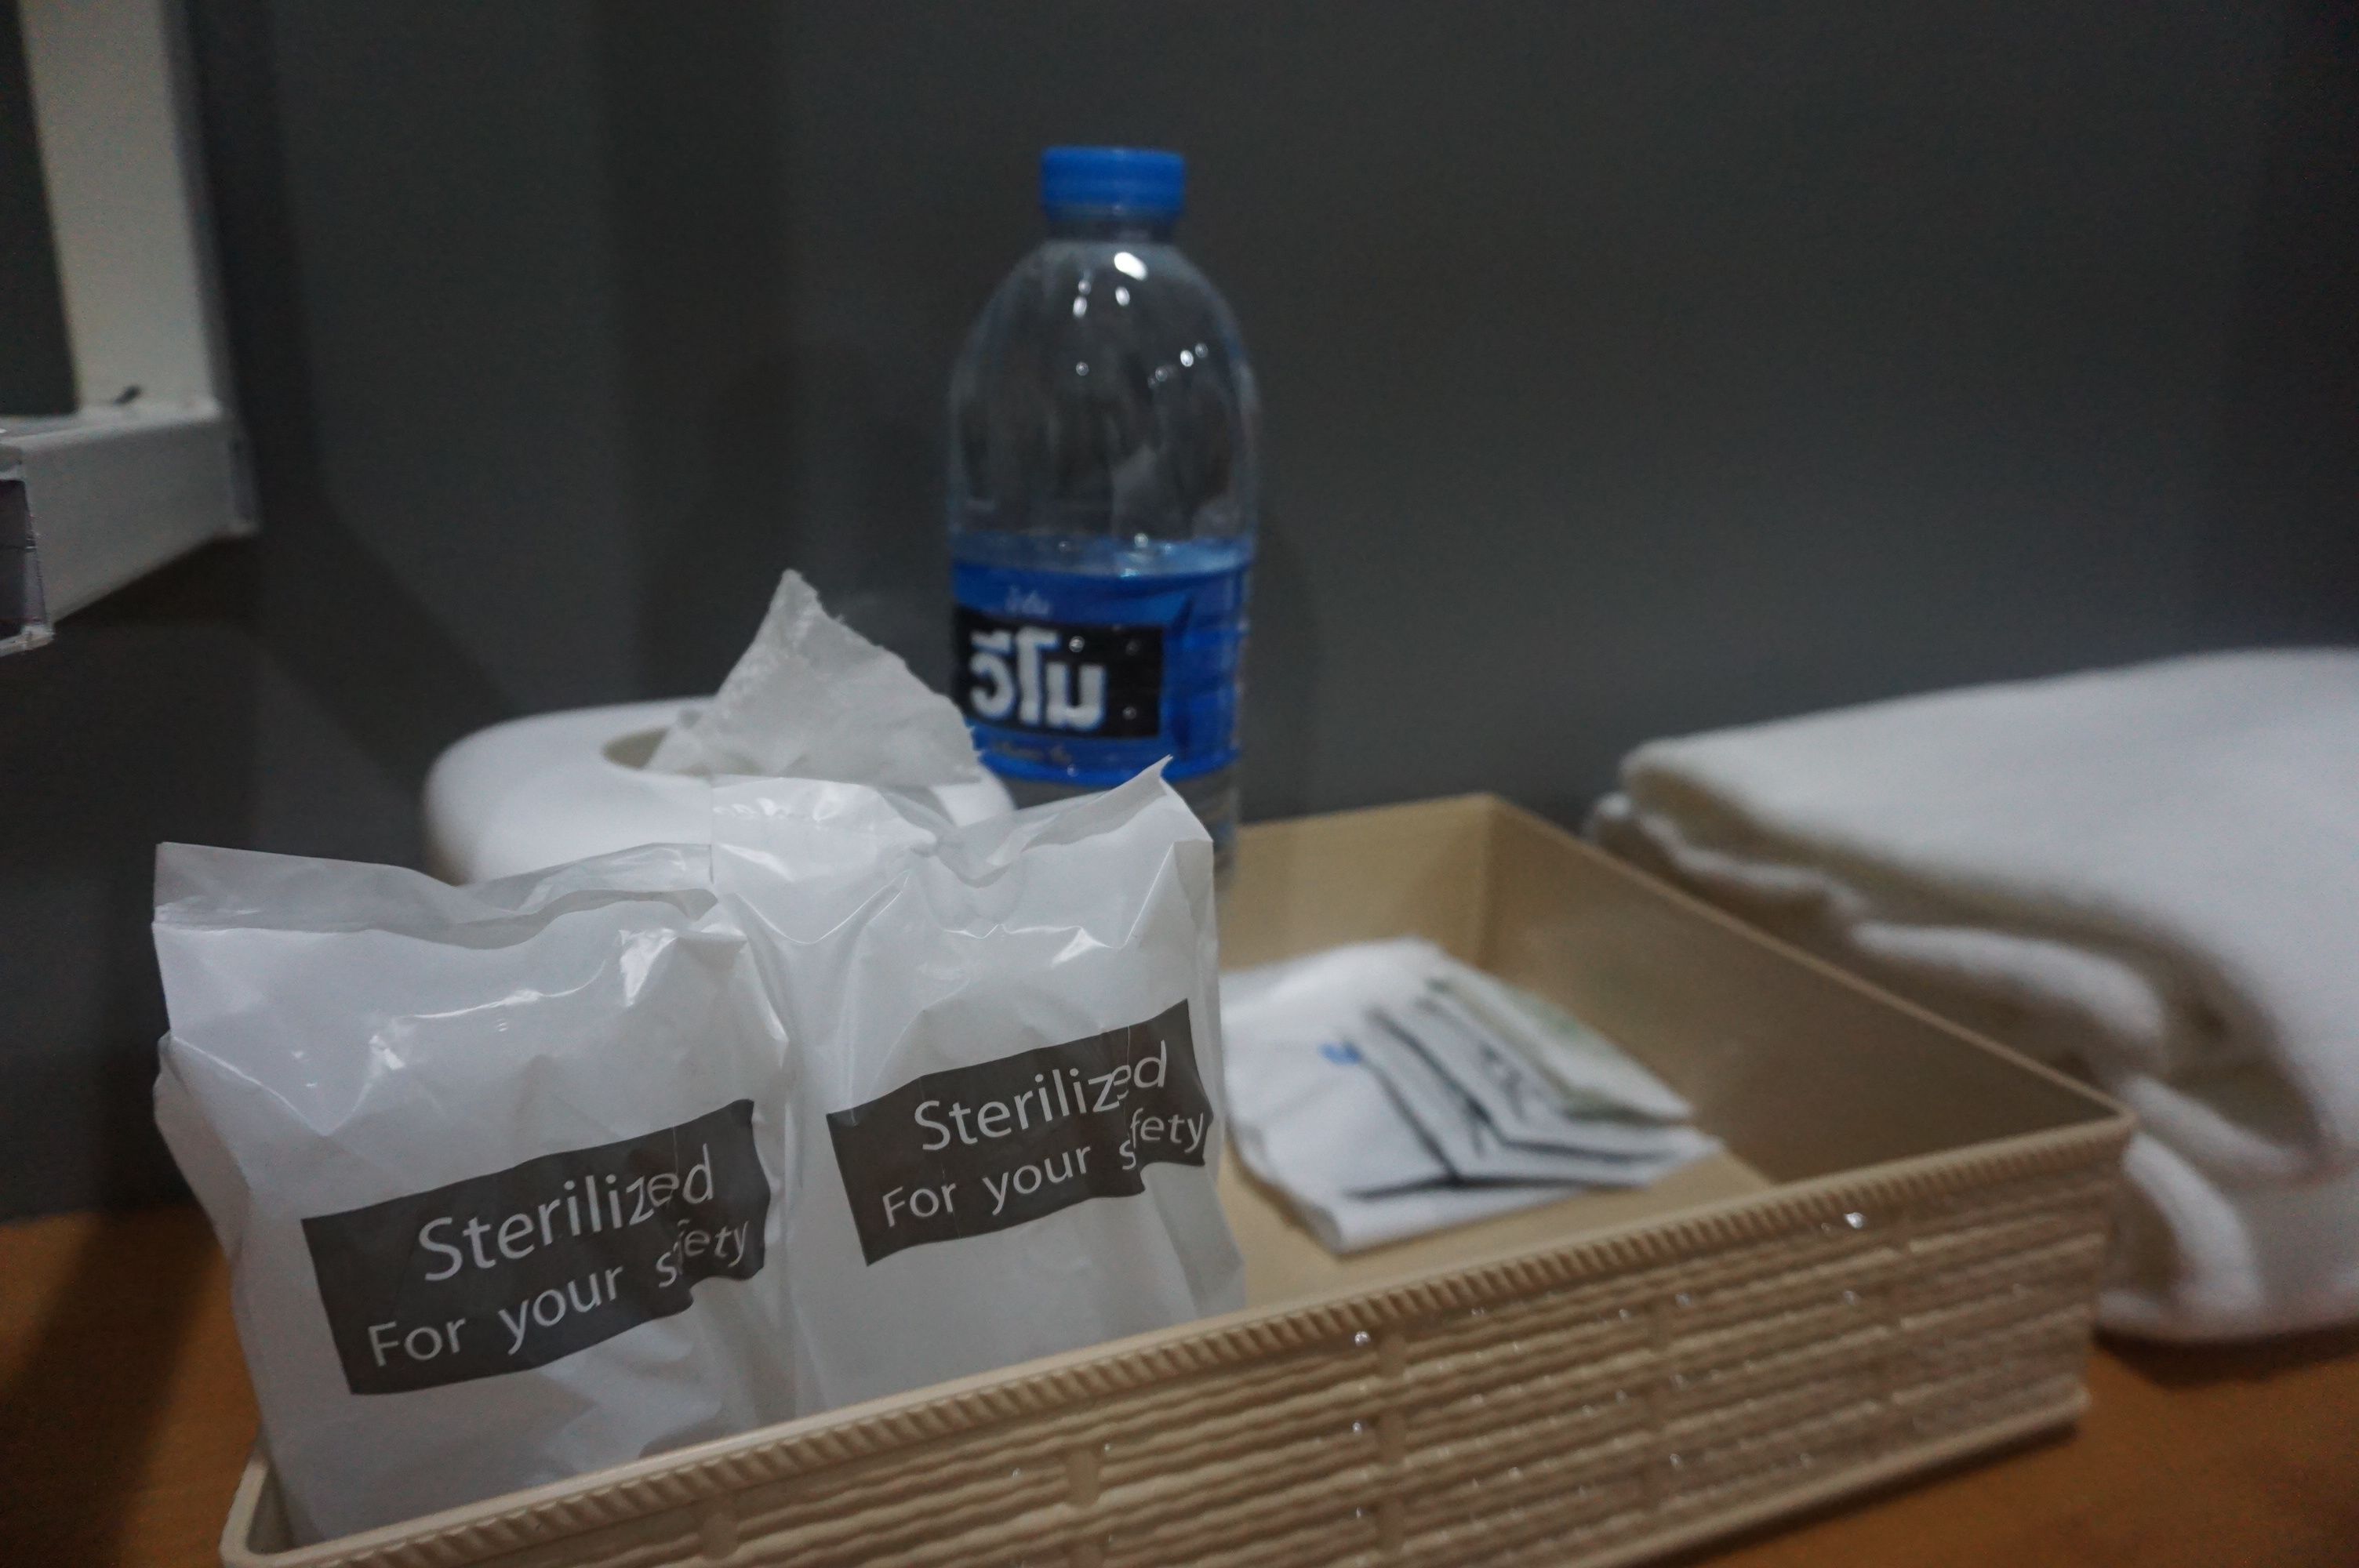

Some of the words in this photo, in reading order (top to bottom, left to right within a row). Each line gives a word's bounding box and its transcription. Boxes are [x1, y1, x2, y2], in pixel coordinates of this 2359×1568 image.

[914, 1040, 1167, 1151] Sterilized
[418, 1142, 714, 1282] Sterilized
[881, 1181, 957, 1228] For
[982, 1145, 1091, 1216] your
[1118, 1107, 1204, 1171] sfety
[367, 1316, 467, 1367] For
[497, 1265, 623, 1356] your
